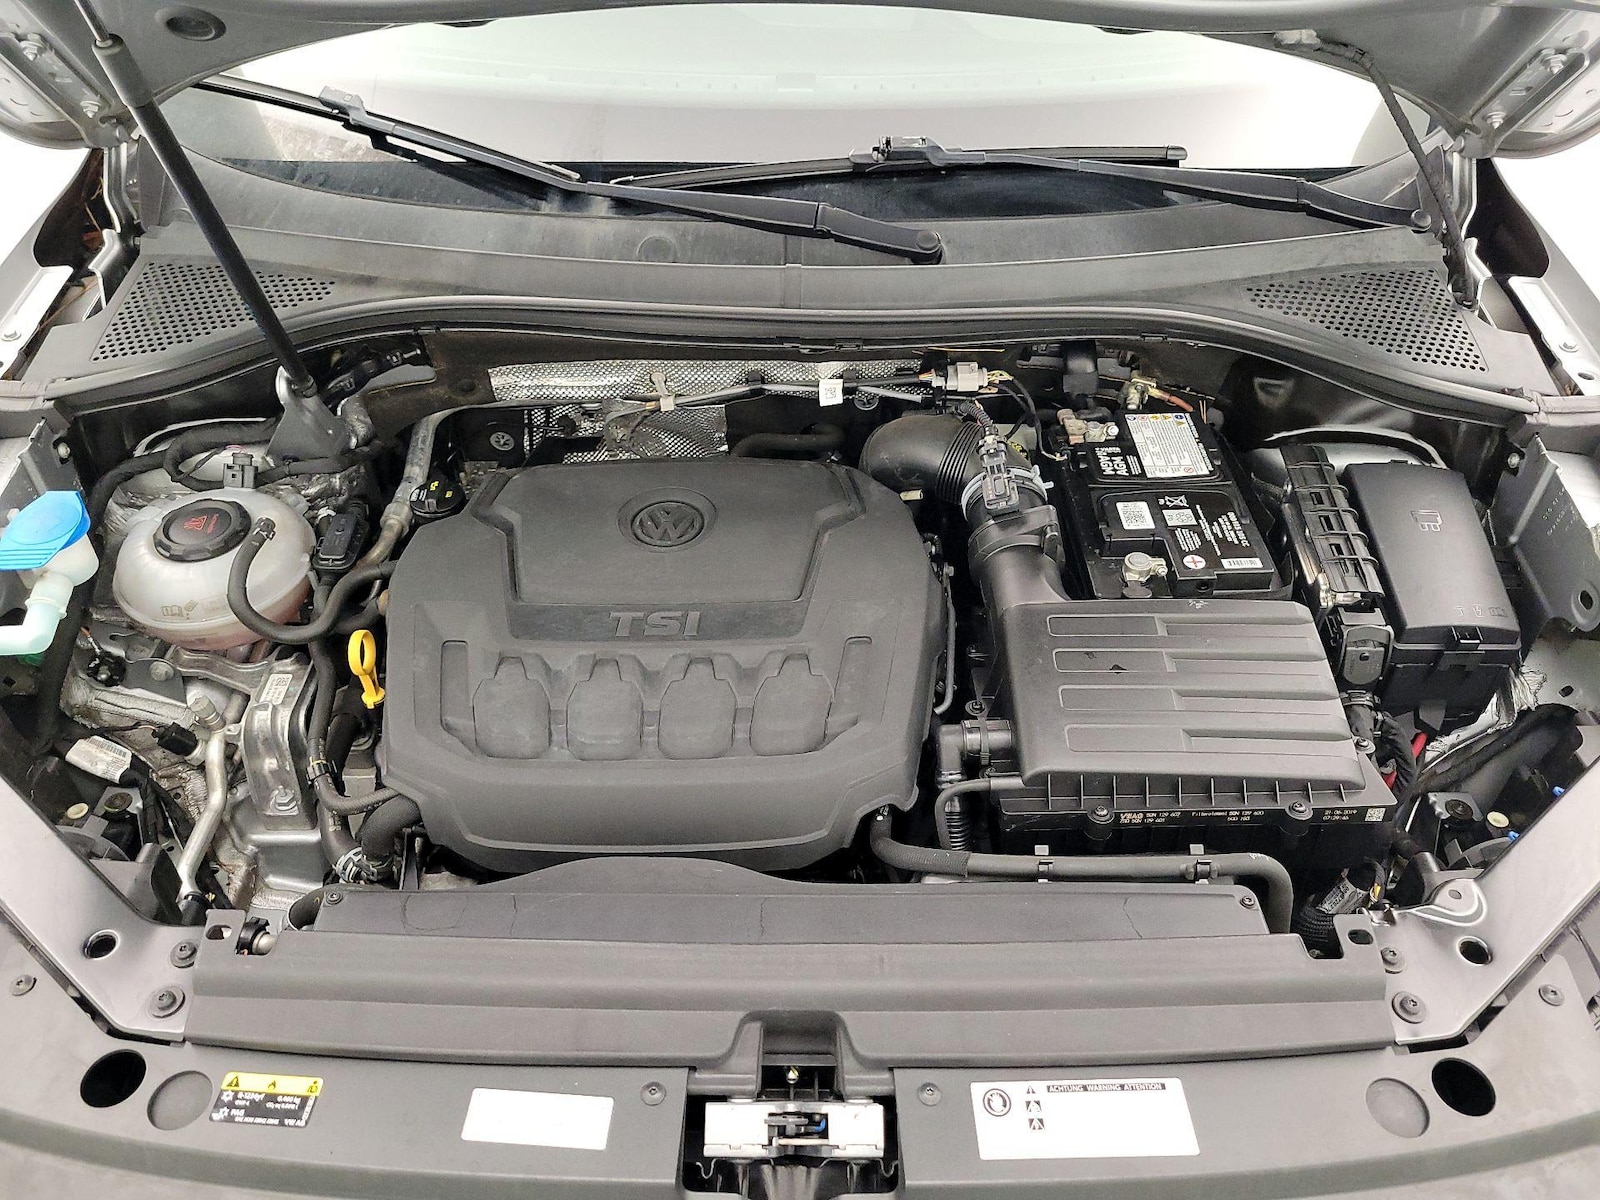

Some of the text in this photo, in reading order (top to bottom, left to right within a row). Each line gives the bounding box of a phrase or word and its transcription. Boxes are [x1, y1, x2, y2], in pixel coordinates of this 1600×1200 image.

[1098, 455, 1115, 475] AGM
[1111, 456, 1129, 476] AGM
[608, 611, 701, 637] TSI
[1049, 1082, 1163, 1093] ACHTUNG WARNING ATTENTION
